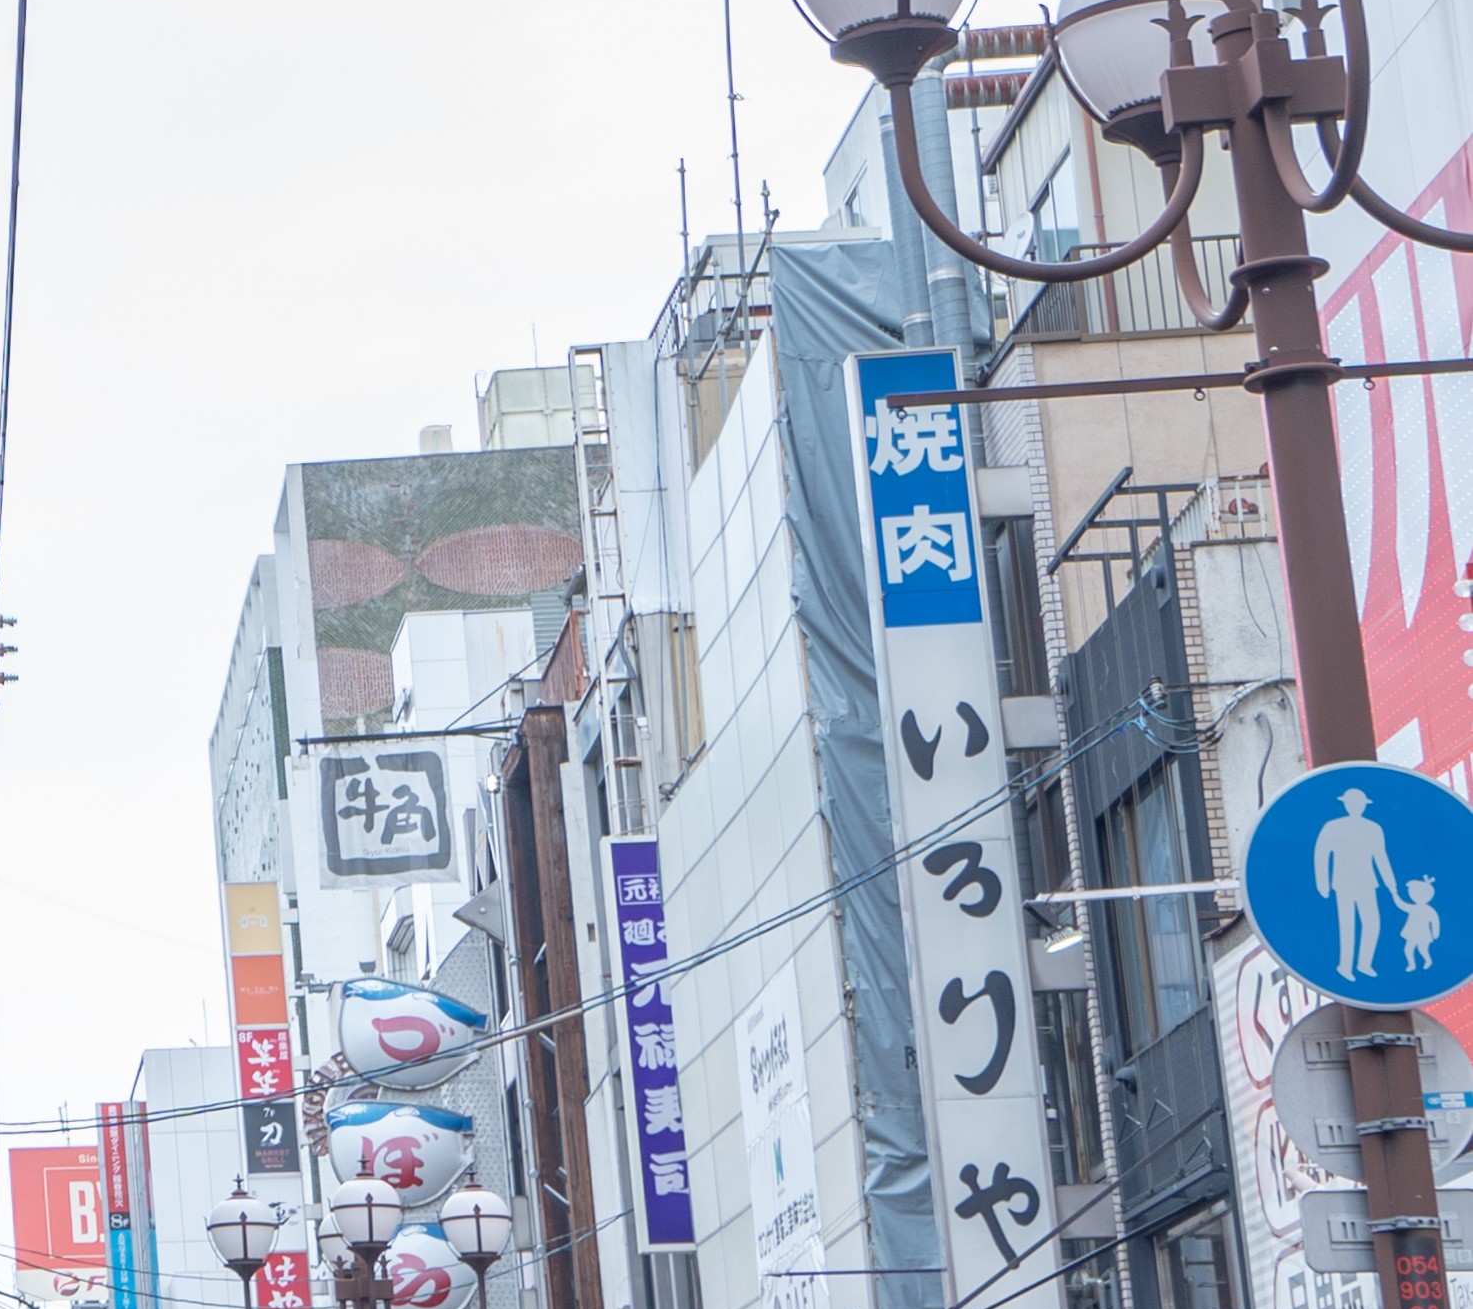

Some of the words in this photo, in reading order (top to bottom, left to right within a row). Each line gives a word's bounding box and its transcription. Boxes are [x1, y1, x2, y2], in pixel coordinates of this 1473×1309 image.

[866, 399, 975, 585] 焼肉
[337, 777, 437, 845] 牛角
[901, 701, 1040, 1268] いろりや
[239, 1032, 253, 1043] 8F
[69, 1181, 105, 1243] B
[1397, 1254, 1440, 1276] 054
[1400, 1280, 1443, 1301] 903
